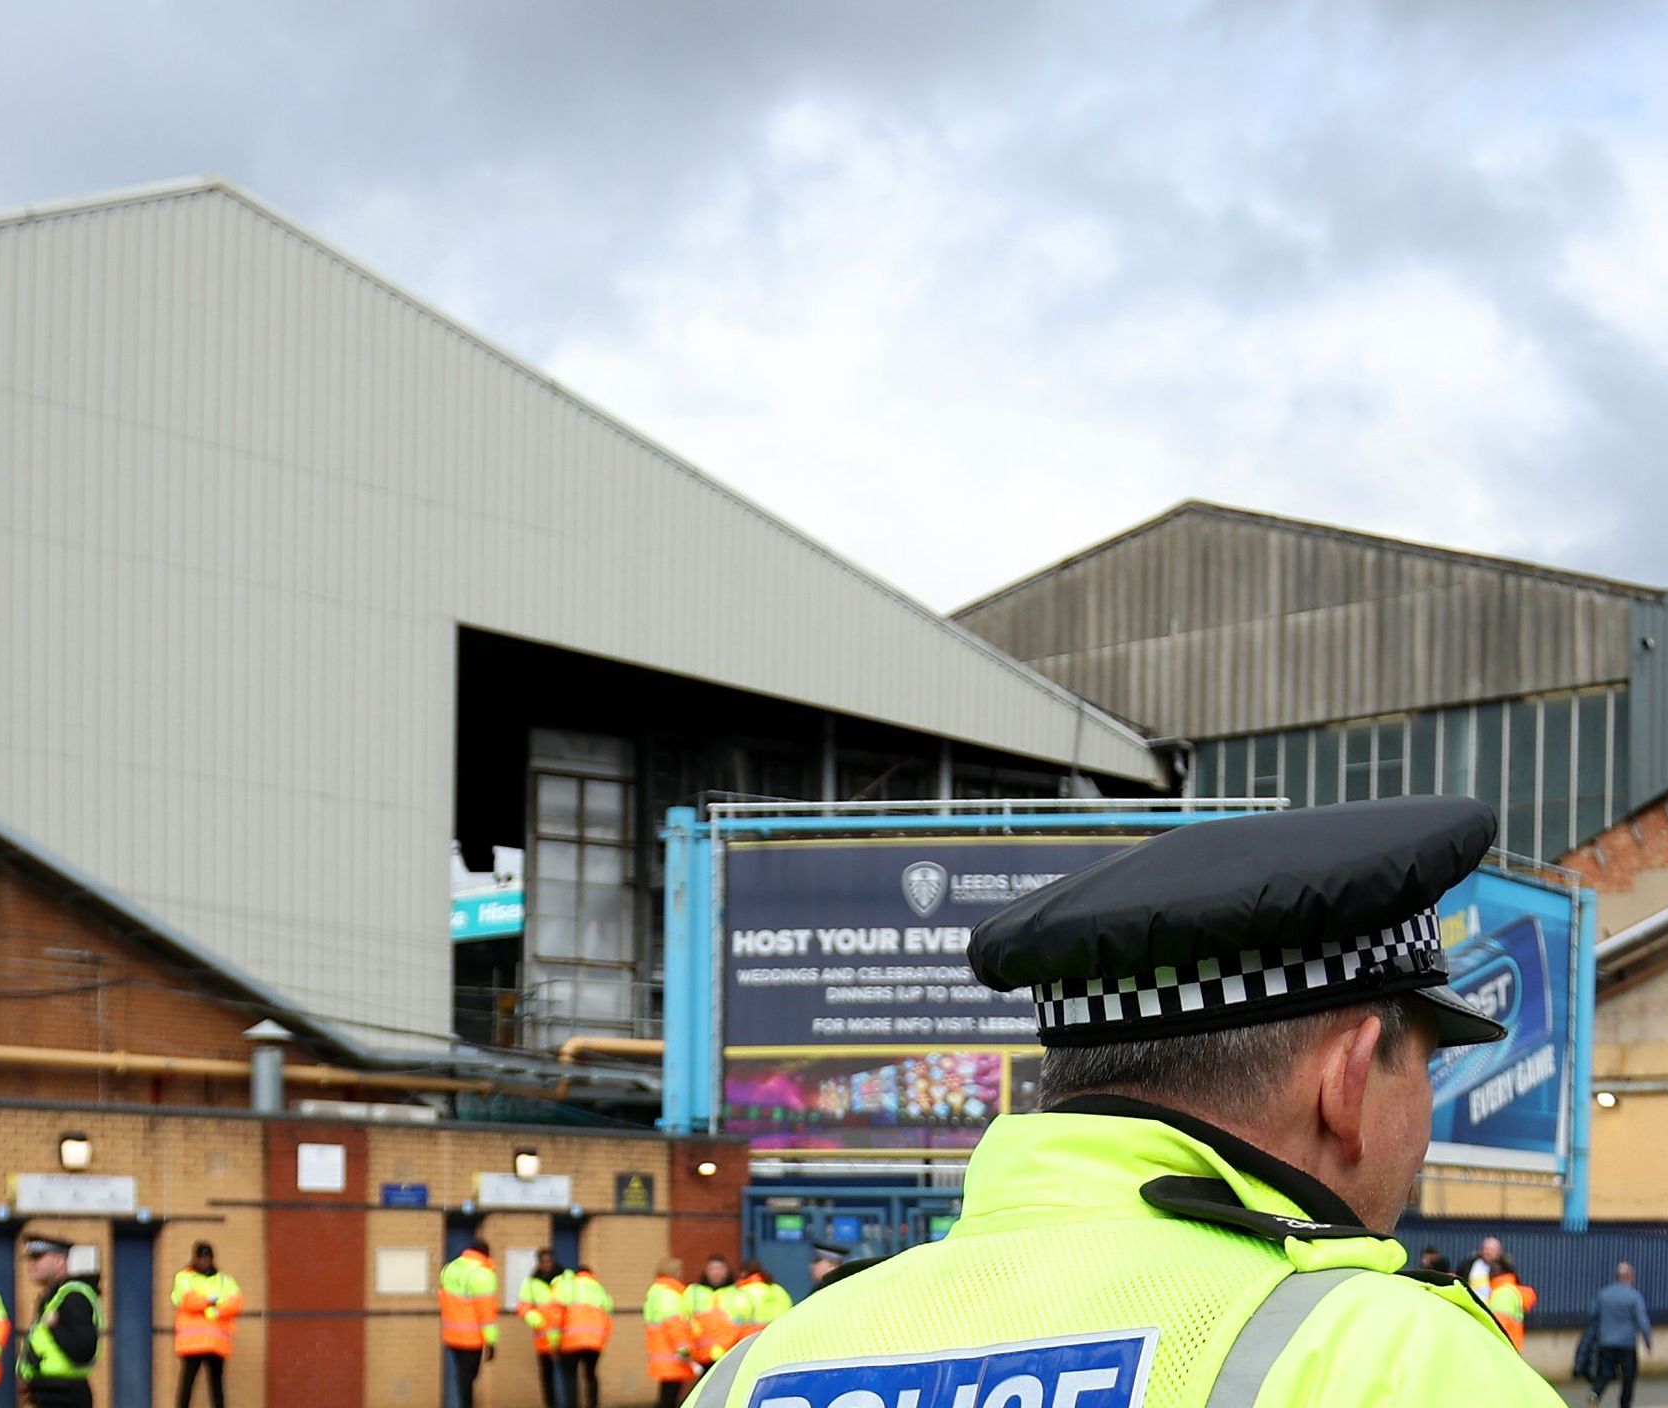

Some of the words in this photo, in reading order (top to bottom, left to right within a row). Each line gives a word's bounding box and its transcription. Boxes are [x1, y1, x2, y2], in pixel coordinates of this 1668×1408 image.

[950, 873, 1009, 890] LEEDS
[732, 929, 812, 956] HOST
[816, 928, 899, 954] YOUR
[736, 968, 820, 986] WEDDINGS
[821, 967, 855, 985] AND
[857, 966, 973, 984] CELEBRATIONS
[826, 987, 894, 1004] DINNERS
[925, 986, 948, 1003] TO
[812, 1017, 845, 1035] FOR
[847, 1017, 892, 1035] MORE
[893, 1017, 932, 1035] INFO
[934, 1017, 977, 1035] VISIT:
[1469, 1067, 1514, 1126] EVERY
[1515, 1043, 1557, 1096] GAME
